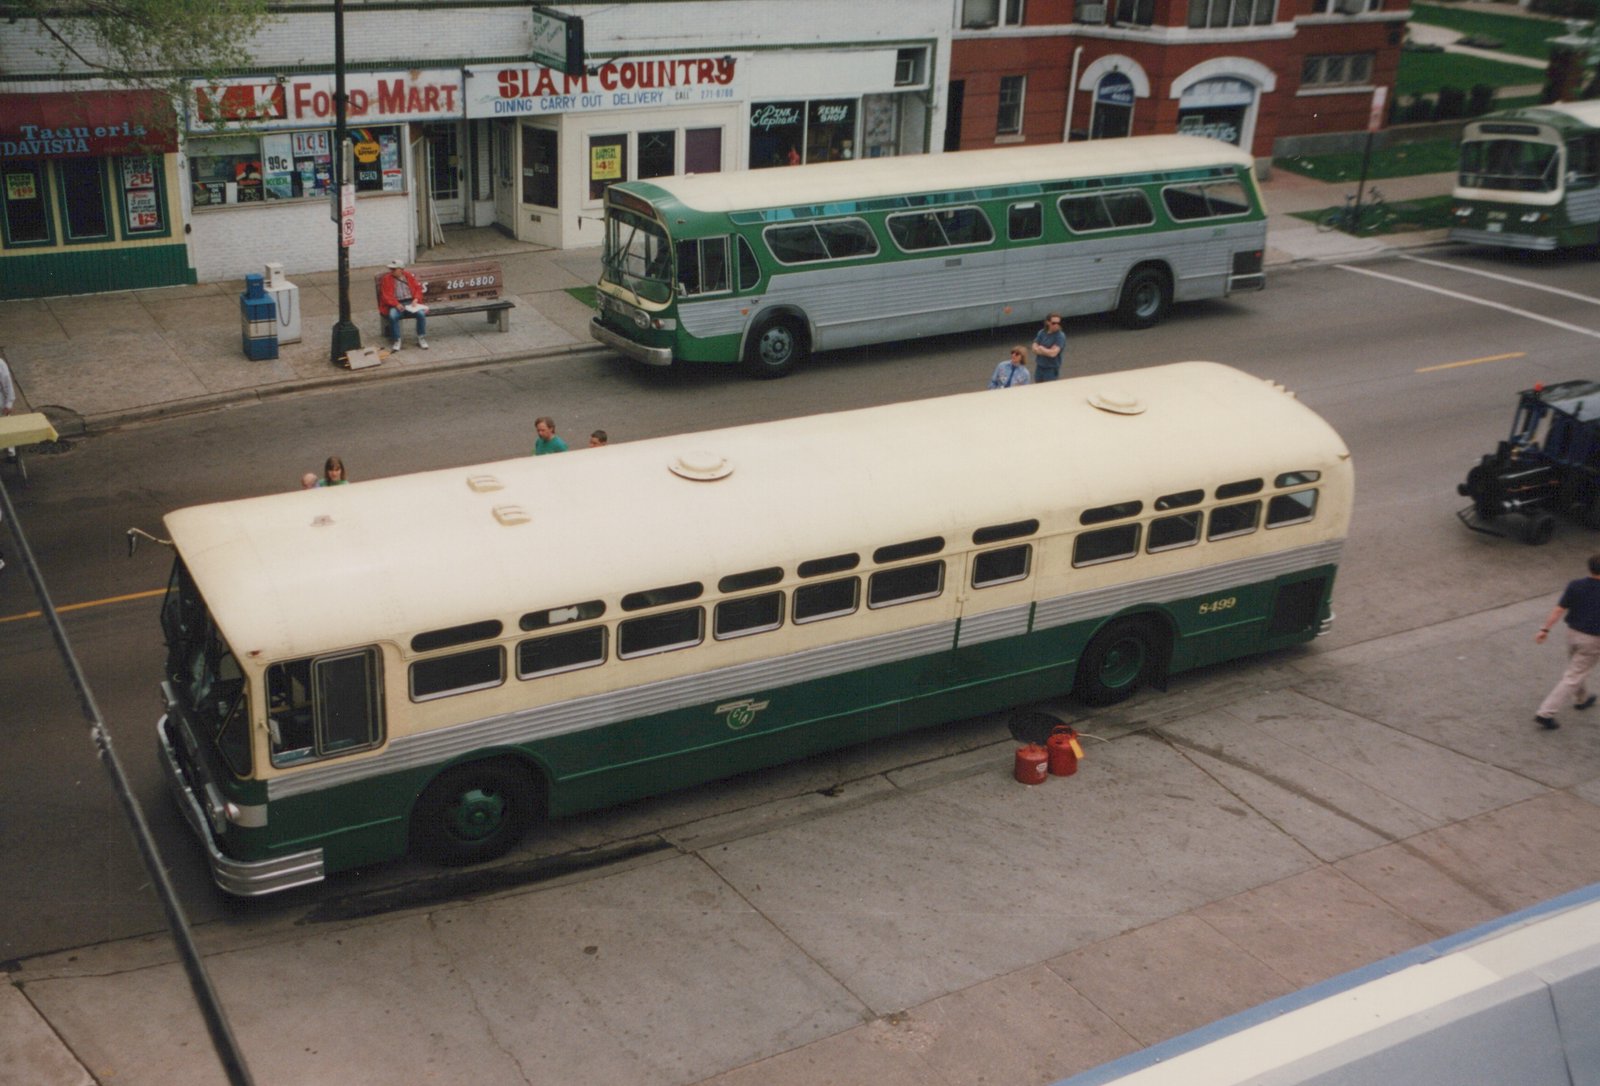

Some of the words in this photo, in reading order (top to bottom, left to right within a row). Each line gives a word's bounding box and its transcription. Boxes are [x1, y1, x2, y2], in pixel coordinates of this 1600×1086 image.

[497, 61, 588, 98] SIAM
[599, 57, 737, 91] COUNTRY
[294, 83, 369, 119] FOD
[377, 79, 459, 115] MART
[494, 99, 533, 114] DINING
[540, 97, 577, 110] CARRY
[581, 94, 603, 108] OUT
[612, 91, 664, 106] DELIVERY
[0, 138, 89, 156] DAVISTA
[446, 275, 496, 290] 266-6800
[1198, 596, 1237, 615] 8-499
